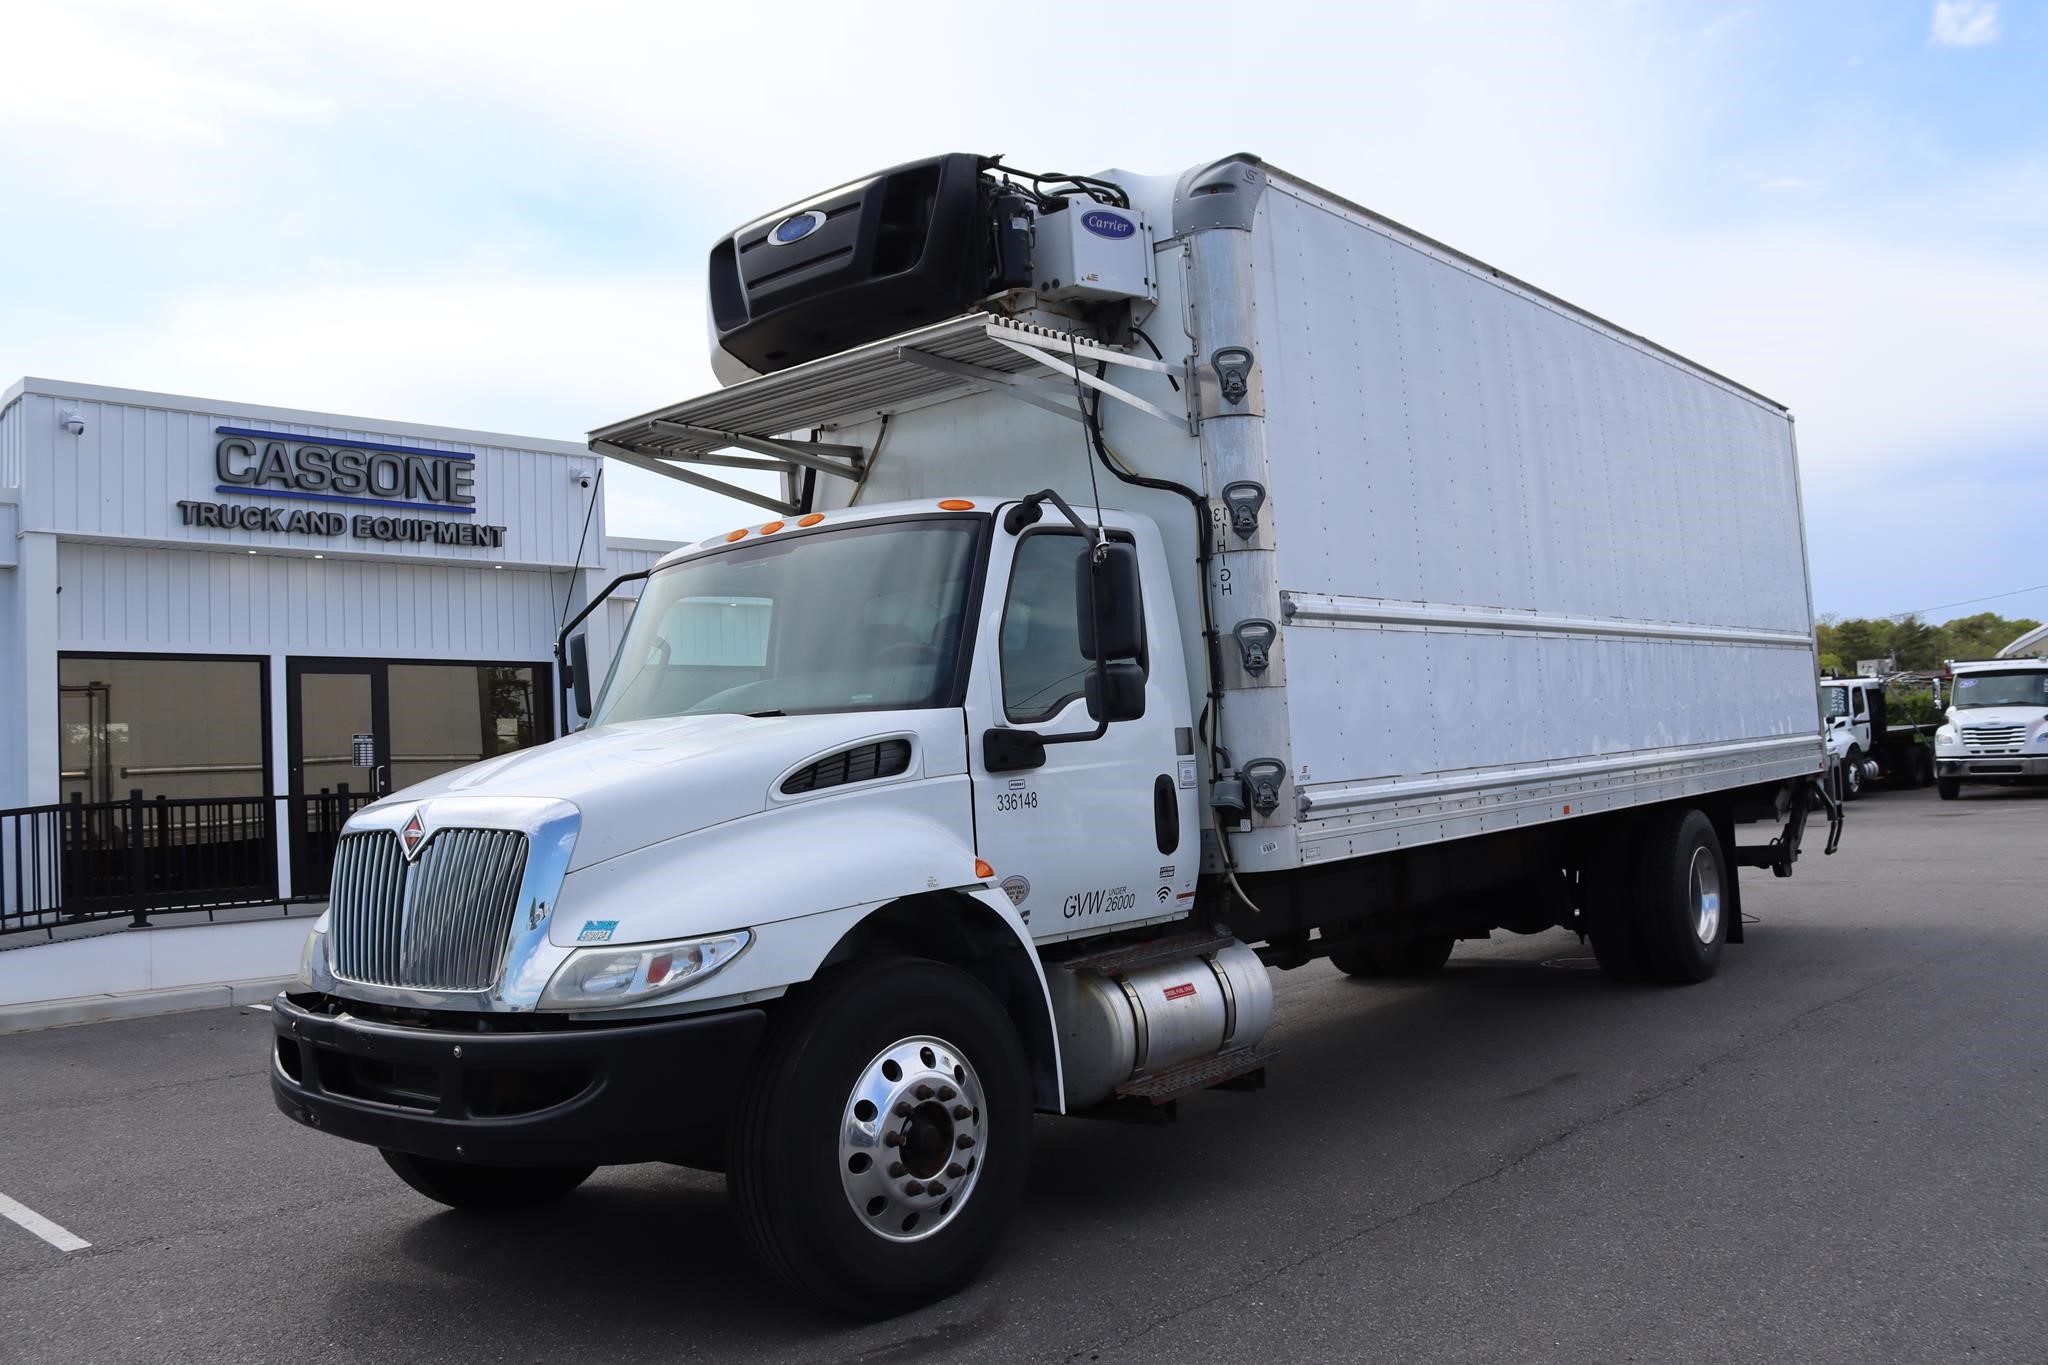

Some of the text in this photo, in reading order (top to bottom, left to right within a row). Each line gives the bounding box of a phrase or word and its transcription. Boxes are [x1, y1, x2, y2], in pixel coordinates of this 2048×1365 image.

[1088, 215, 1129, 232] Carrier
[216, 437, 475, 503] CASSONE
[177, 500, 507, 548] TRUCK AND EQUIPMENT
[996, 791, 1038, 812] 336148
[1108, 886, 1127, 896] UNDER
[1063, 889, 1106, 919] GVW
[1104, 893, 1136, 913] 26000
